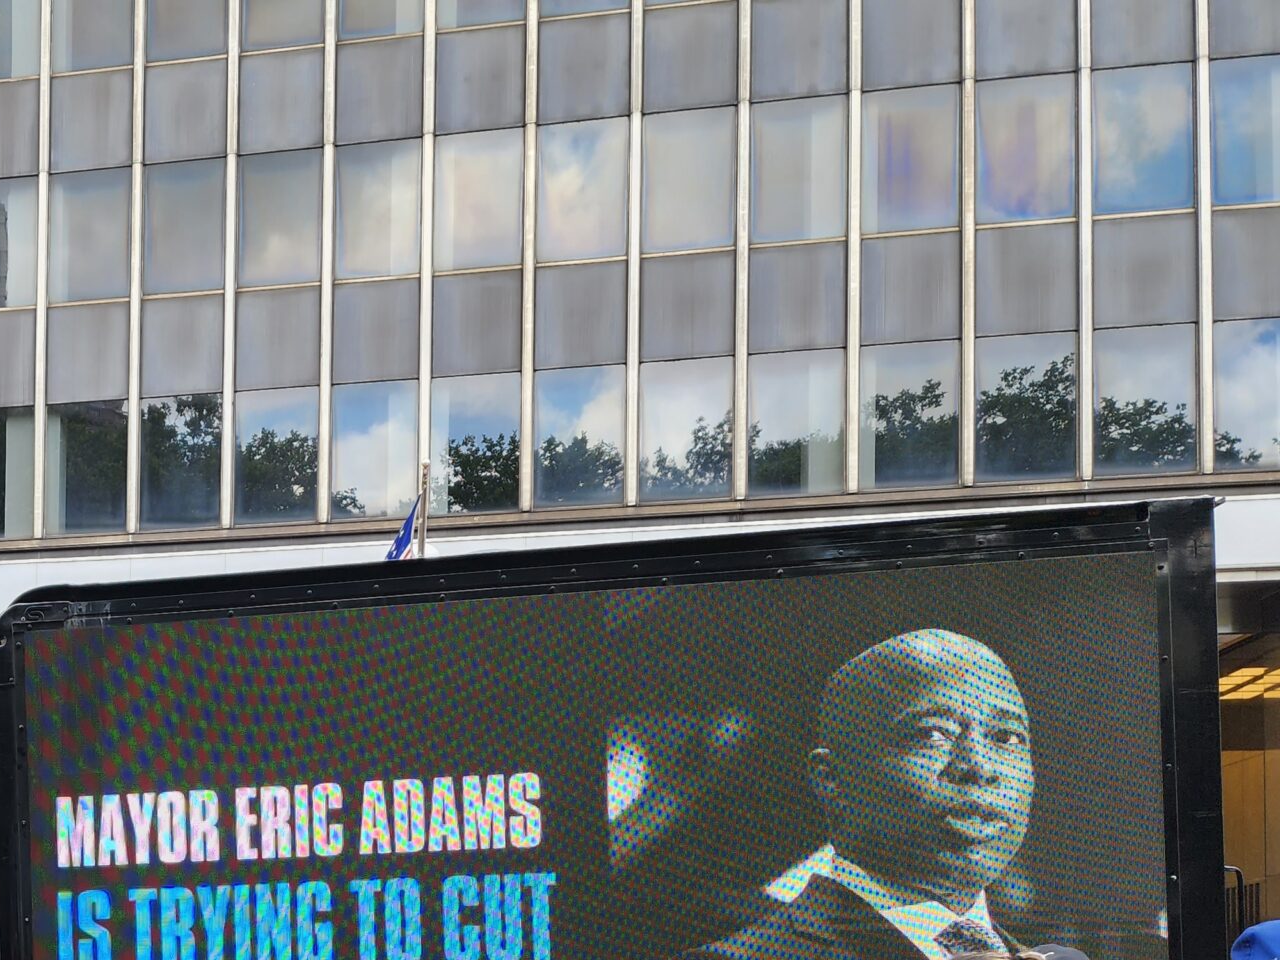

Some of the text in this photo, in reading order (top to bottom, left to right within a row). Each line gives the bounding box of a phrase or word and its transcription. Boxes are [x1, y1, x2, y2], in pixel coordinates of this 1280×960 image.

[56, 771, 542, 868] MAYOR ERIC ADAMS
